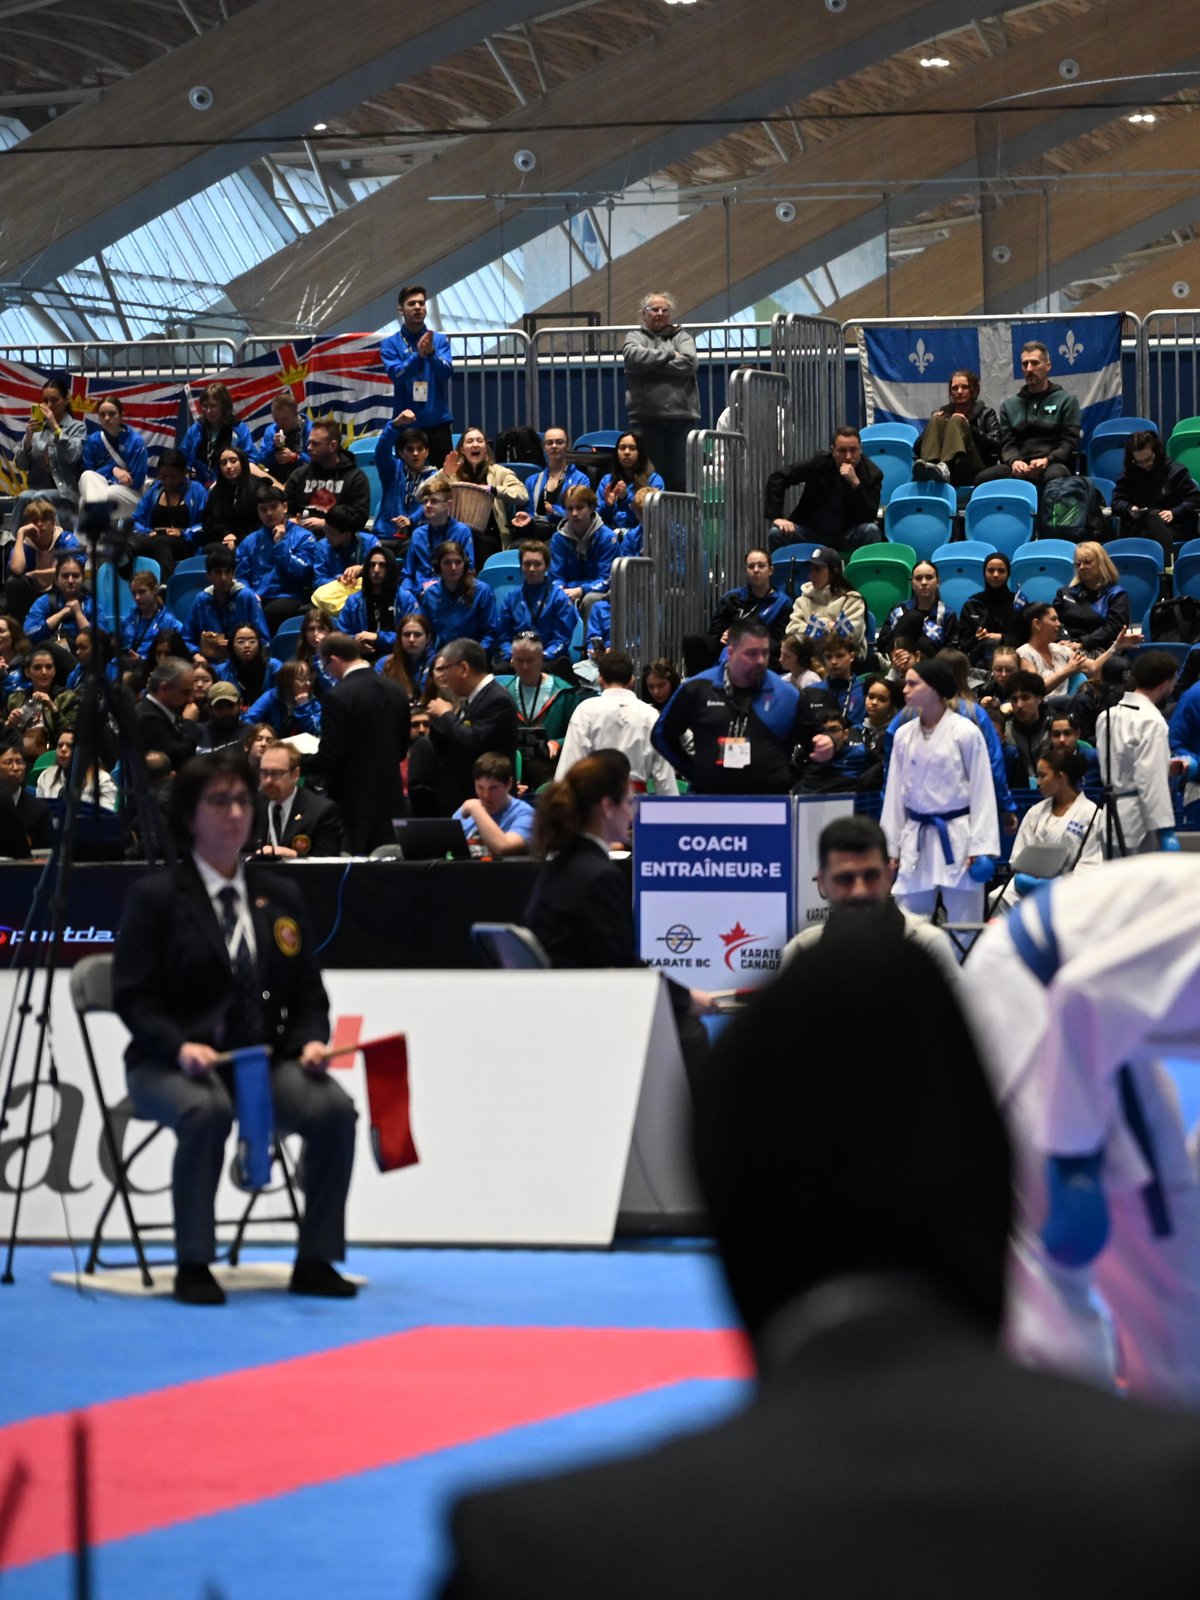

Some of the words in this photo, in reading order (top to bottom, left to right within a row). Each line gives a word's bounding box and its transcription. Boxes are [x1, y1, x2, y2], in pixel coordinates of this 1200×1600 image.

[678, 836, 748, 851] COACH
[641, 858, 782, 878] ENTRAÎNEUR·E
[741, 949, 781, 960] KARATE
[647, 958, 692, 968] KARATE
[696, 958, 711, 968] BC
